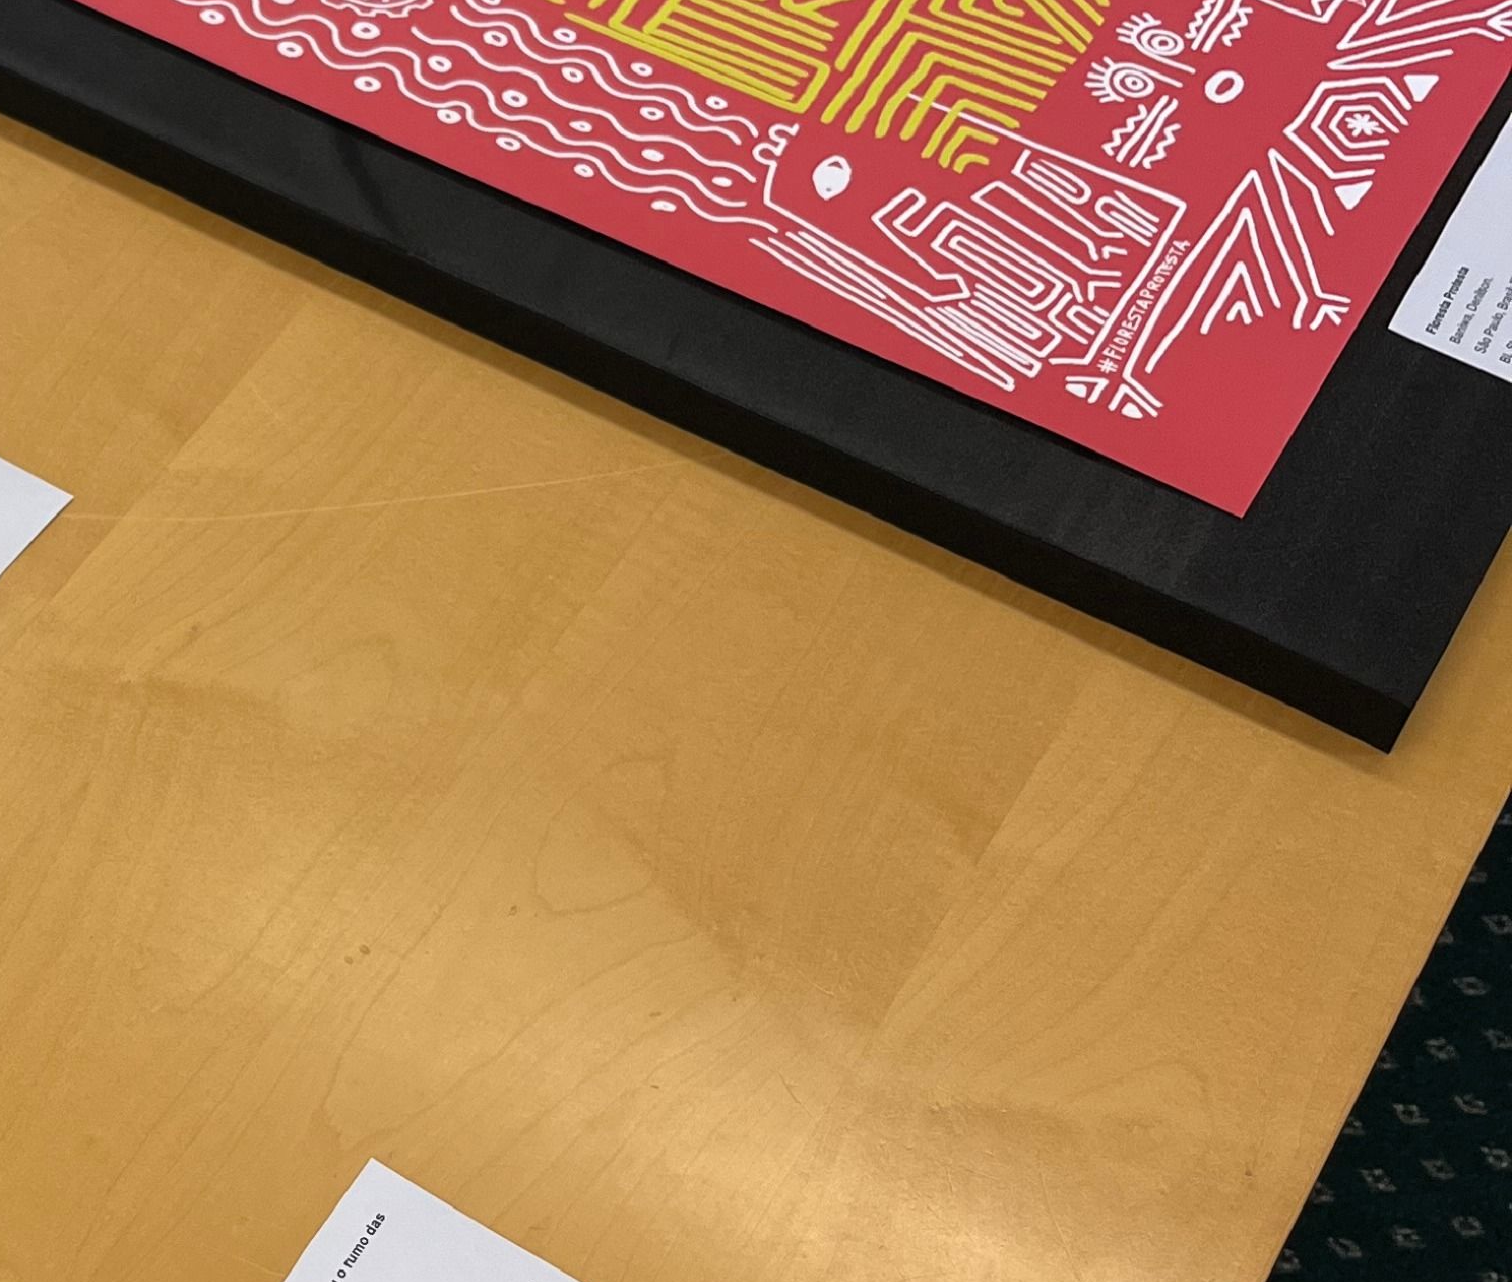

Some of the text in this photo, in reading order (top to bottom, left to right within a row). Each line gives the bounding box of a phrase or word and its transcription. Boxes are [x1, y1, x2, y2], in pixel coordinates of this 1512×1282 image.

[1097, 239, 1191, 374] #FLORESTAPROTESTA
[1425, 265, 1470, 336] Floresta Protesta
[336, 1268, 347, 1279] o
[343, 1236, 369, 1269] rumo
[365, 1213, 386, 1236] das
